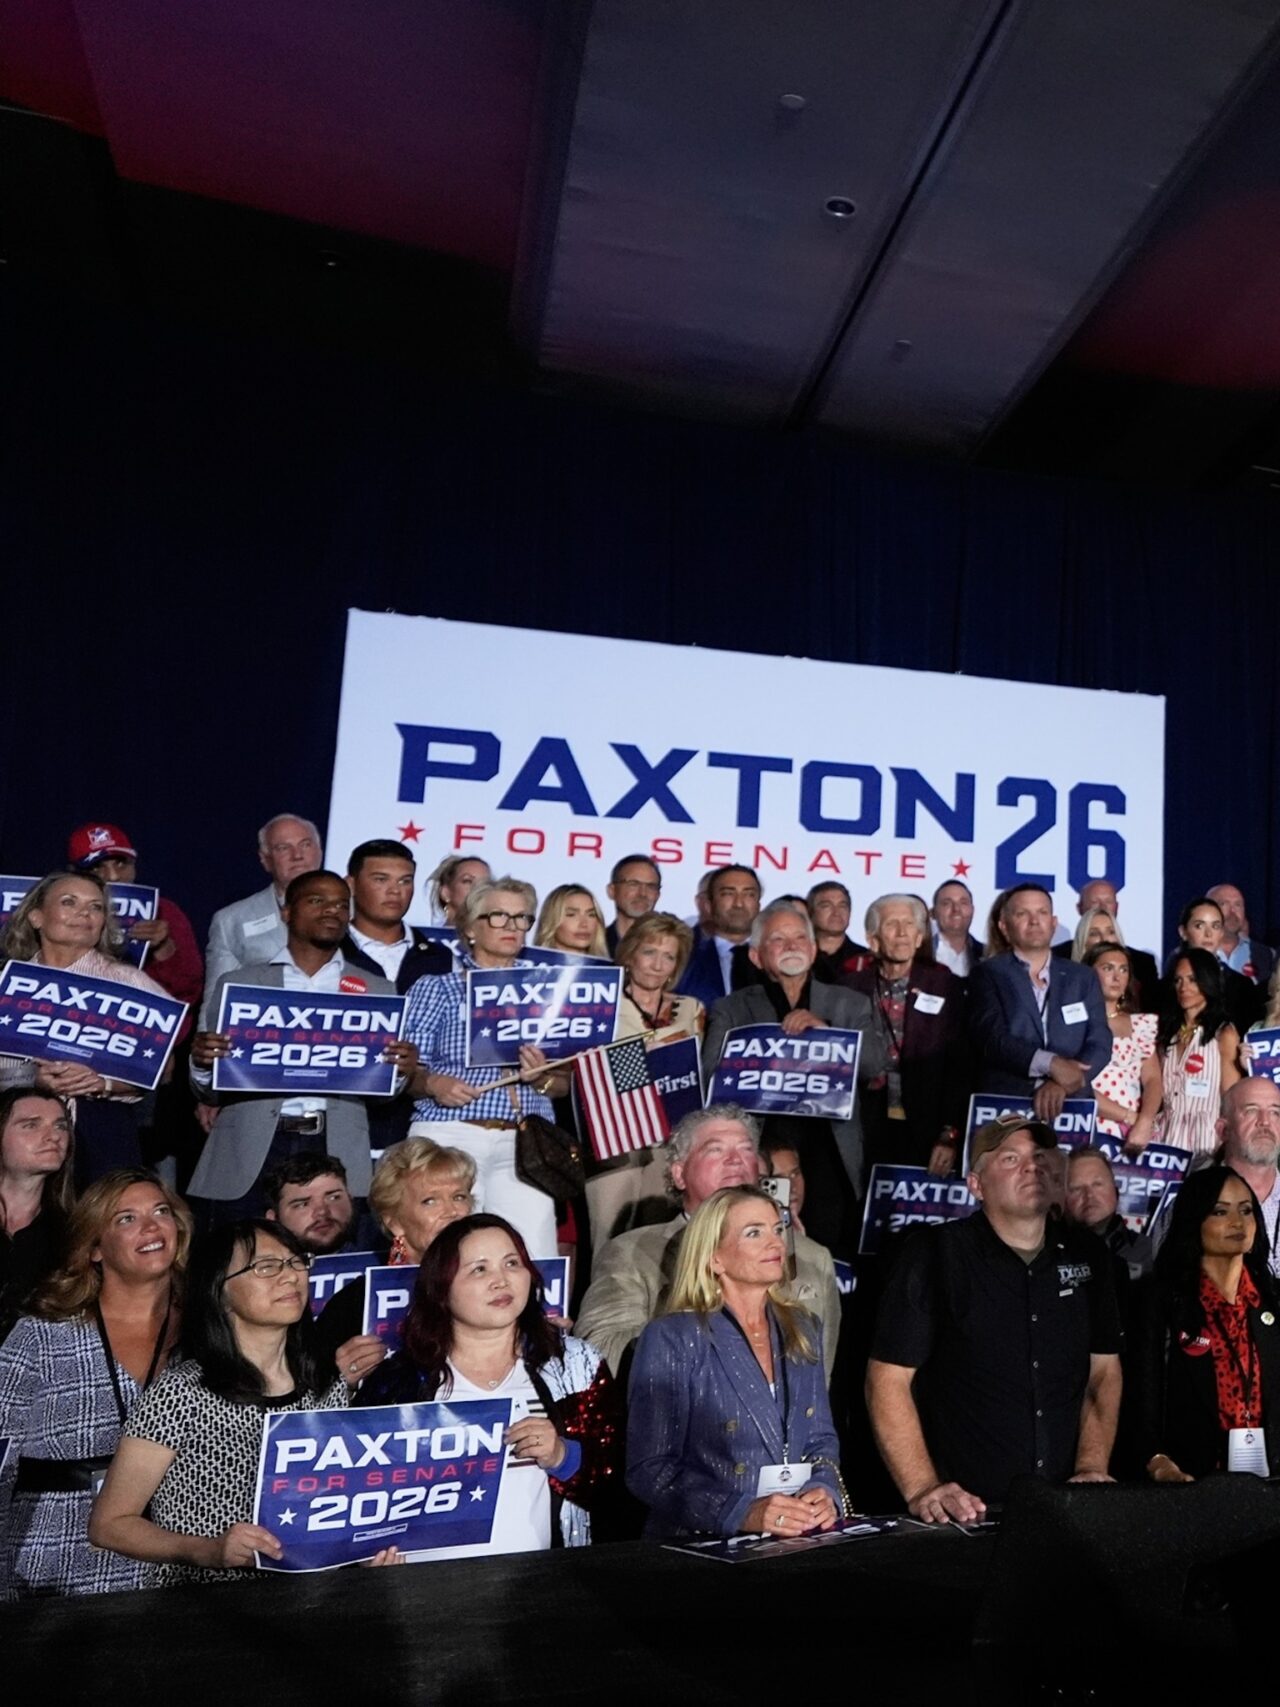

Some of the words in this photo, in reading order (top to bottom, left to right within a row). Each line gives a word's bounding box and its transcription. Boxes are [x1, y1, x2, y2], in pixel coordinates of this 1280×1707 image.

[394, 722, 975, 843] PAXTON
[994, 776, 1126, 895] 26
[453, 824, 604, 858] FOR
[650, 837, 927, 879] SENATE
[5, 976, 177, 1034] PAXTON
[474, 983, 617, 1007] PAXTON
[229, 1002, 400, 1033] PAXTON
[529, 1005, 614, 1018] SNATE
[17, 1013, 139, 1058] 2026
[228, 1028, 280, 1041] FOR
[294, 1032, 397, 1045] SENATE
[497, 1017, 594, 1041] 2026
[251, 1043, 368, 1068] 2026
[723, 1038, 855, 1063] PAXTON
[737, 1070, 830, 1094] 2026
[275, 1422, 505, 1474] PAXTON
[272, 1475, 347, 1494] FOR
[366, 1458, 500, 1487] SENATE
[307, 1481, 463, 1531] 2026
